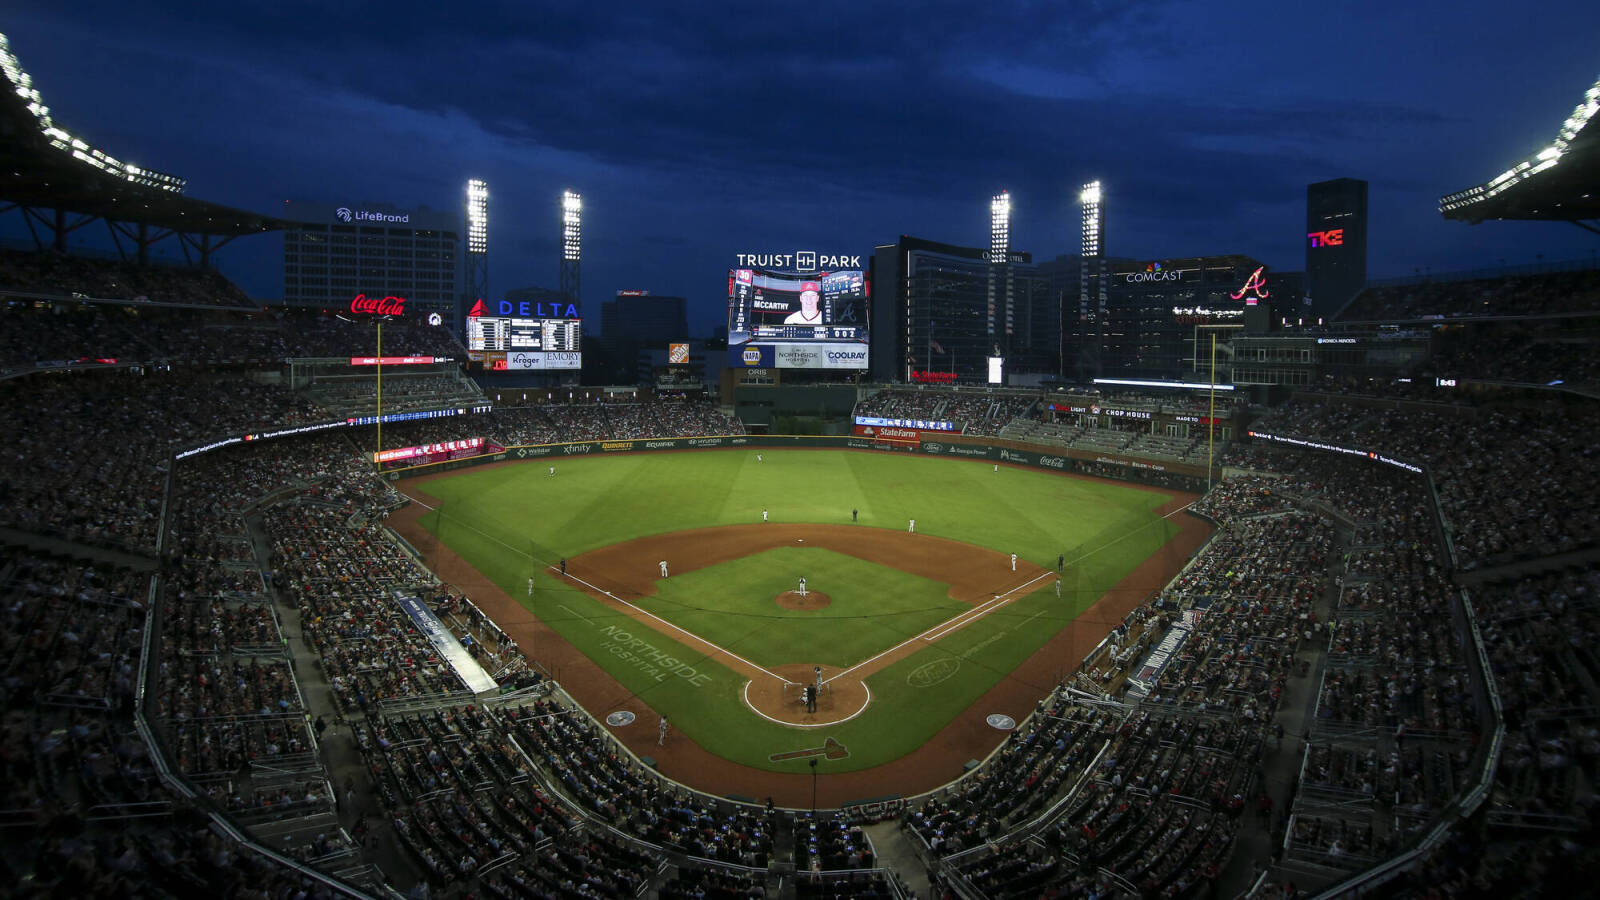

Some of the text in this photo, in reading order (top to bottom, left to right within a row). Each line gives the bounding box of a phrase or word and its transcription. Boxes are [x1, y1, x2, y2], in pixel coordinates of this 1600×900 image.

[355, 211, 409, 223] LifeBrand
[1307, 229, 1343, 248] TKE
[737, 254, 861, 268] TRUIST PARK
[739, 271, 750, 281] 30
[1126, 271, 1184, 283] COMCAST
[498, 300, 578, 317] DELTA
[753, 300, 790, 311] MCCARTHY
[512, 353, 540, 369] Kroger
[547, 352, 579, 361] EMORY
[744, 351, 760, 361] NAPA
[828, 351, 866, 360] COOLRAY
[1105, 409, 1151, 420] CHOP HOUSE
[563, 443, 592, 455] xfinity
[599, 624, 713, 687] NORTHSIDE
[599, 640, 668, 683] HOSPITAL
